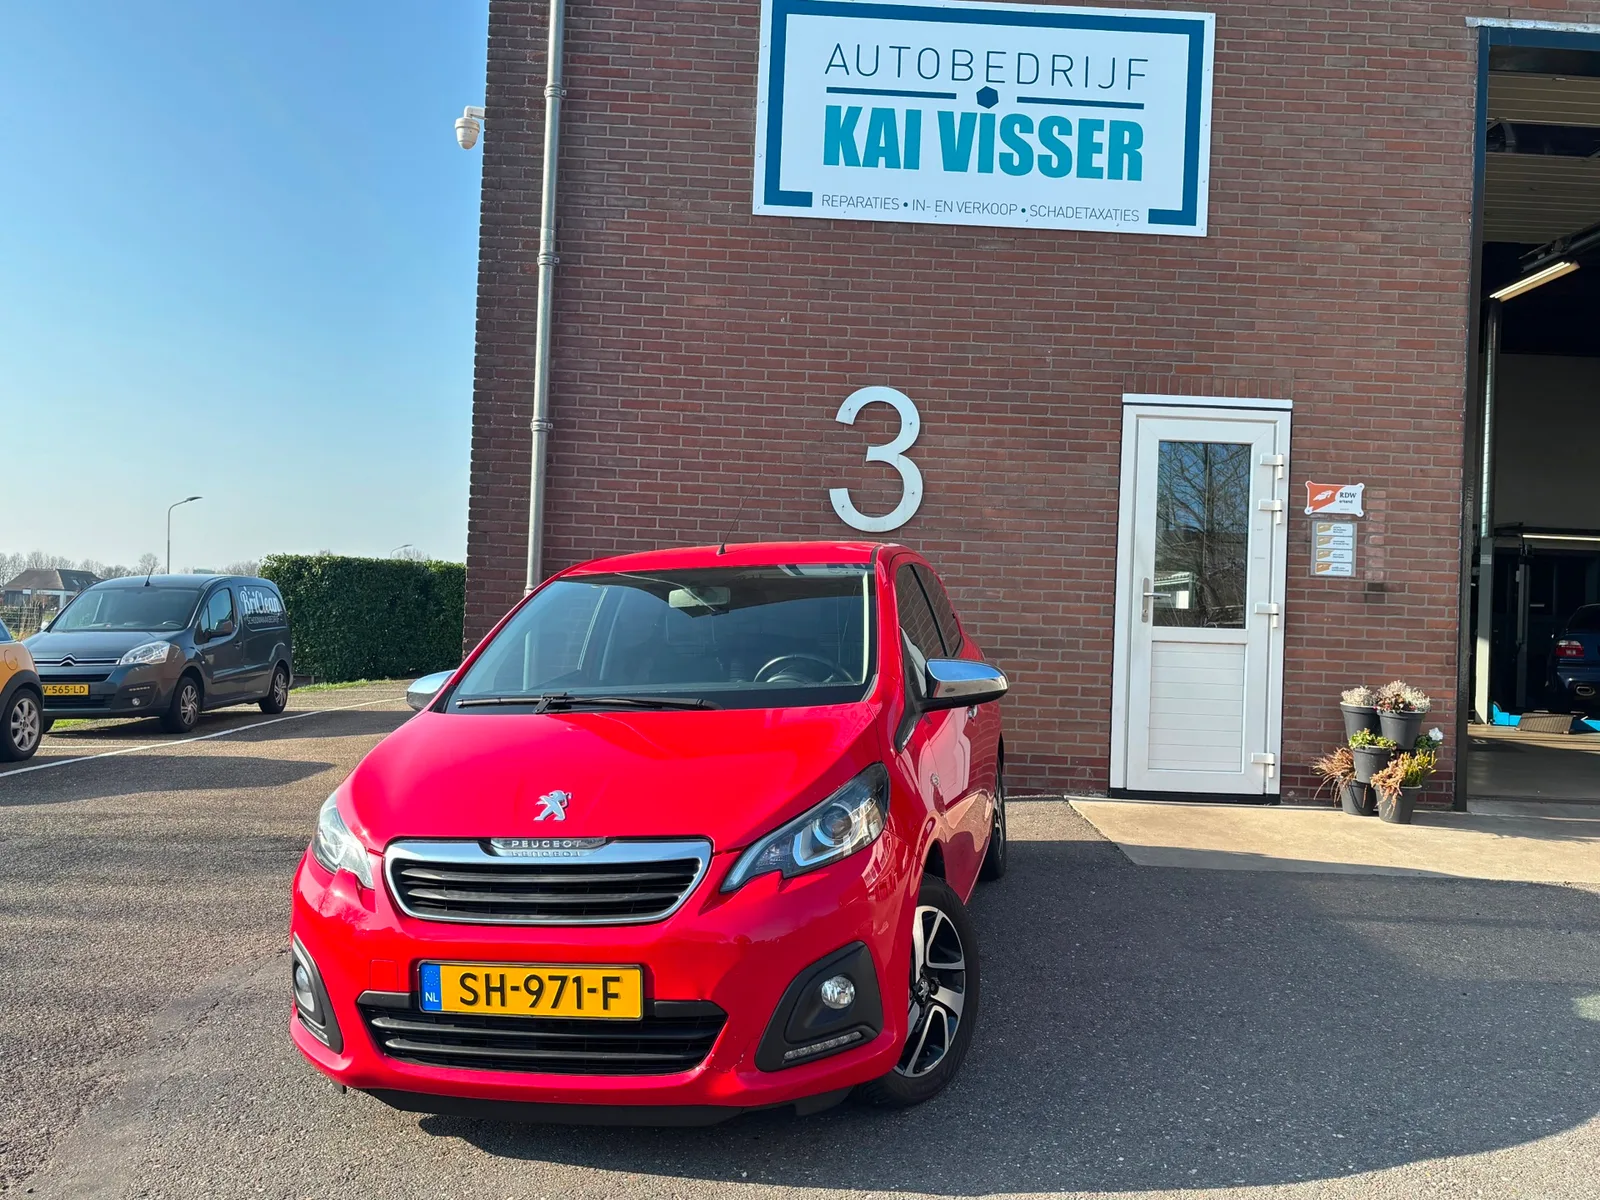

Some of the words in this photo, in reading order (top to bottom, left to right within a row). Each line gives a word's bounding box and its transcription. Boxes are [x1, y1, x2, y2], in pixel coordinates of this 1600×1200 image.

[824, 42, 1149, 91] AUTOBEDRIJF
[822, 104, 923, 170] KAI
[937, 109, 1144, 182] VISSER
[821, 193, 900, 211] REPARATIES
[912, 198, 931, 212] IN-
[935, 199, 953, 213] EN
[956, 201, 1018, 216] VERKOOP
[1029, 204, 1140, 223] SCHADETAXATIES
[829, 386, 924, 533] 3
[1339, 491, 1357, 499] RDW
[42, 685, 86, 694] V-565-LD
[511, 839, 582, 849] PEUGEOT
[425, 992, 440, 1003] NL
[459, 972, 621, 1011] SH-971-F
